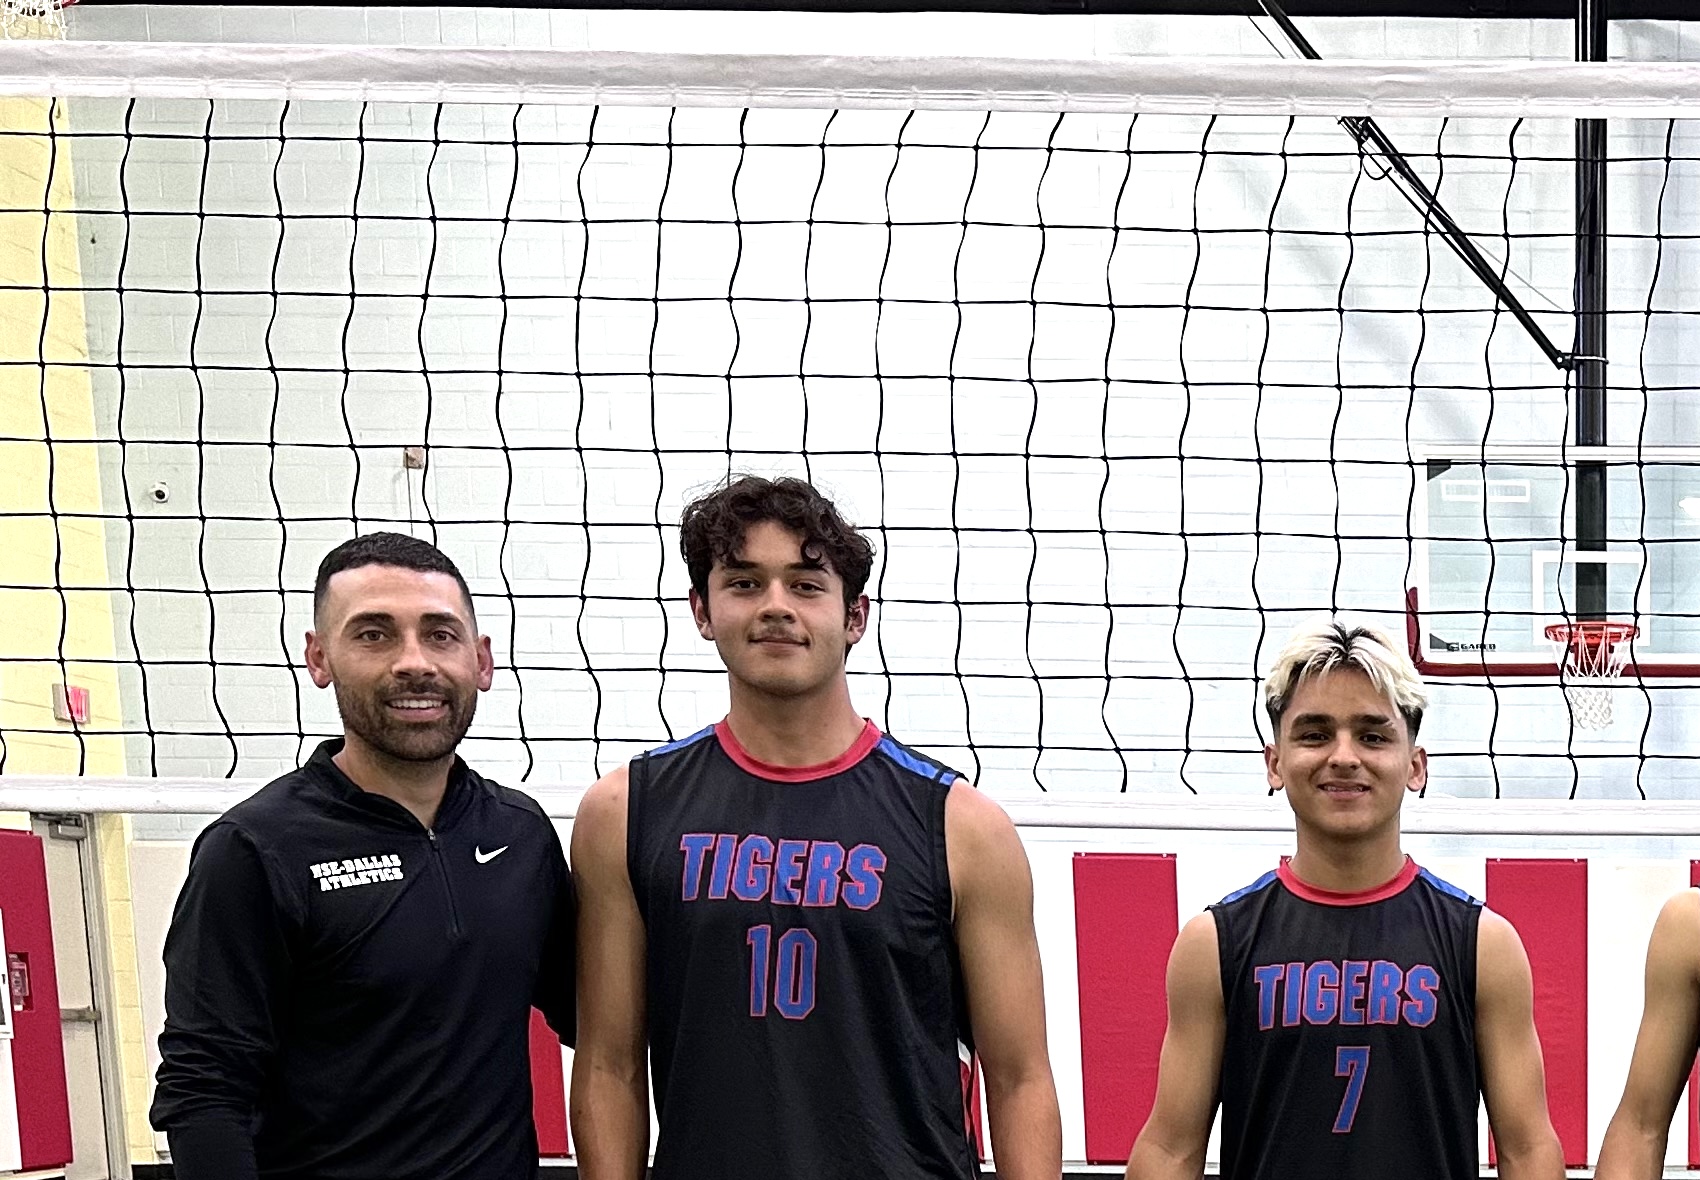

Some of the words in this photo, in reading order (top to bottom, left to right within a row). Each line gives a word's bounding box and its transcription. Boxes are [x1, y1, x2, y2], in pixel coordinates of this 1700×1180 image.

[319, 867, 404, 892] ATHLETICS
[679, 832, 888, 911] TIGERS
[746, 924, 818, 1020] 10
[1253, 959, 1441, 1031] TIGERS
[1331, 1045, 1371, 1134] 7
